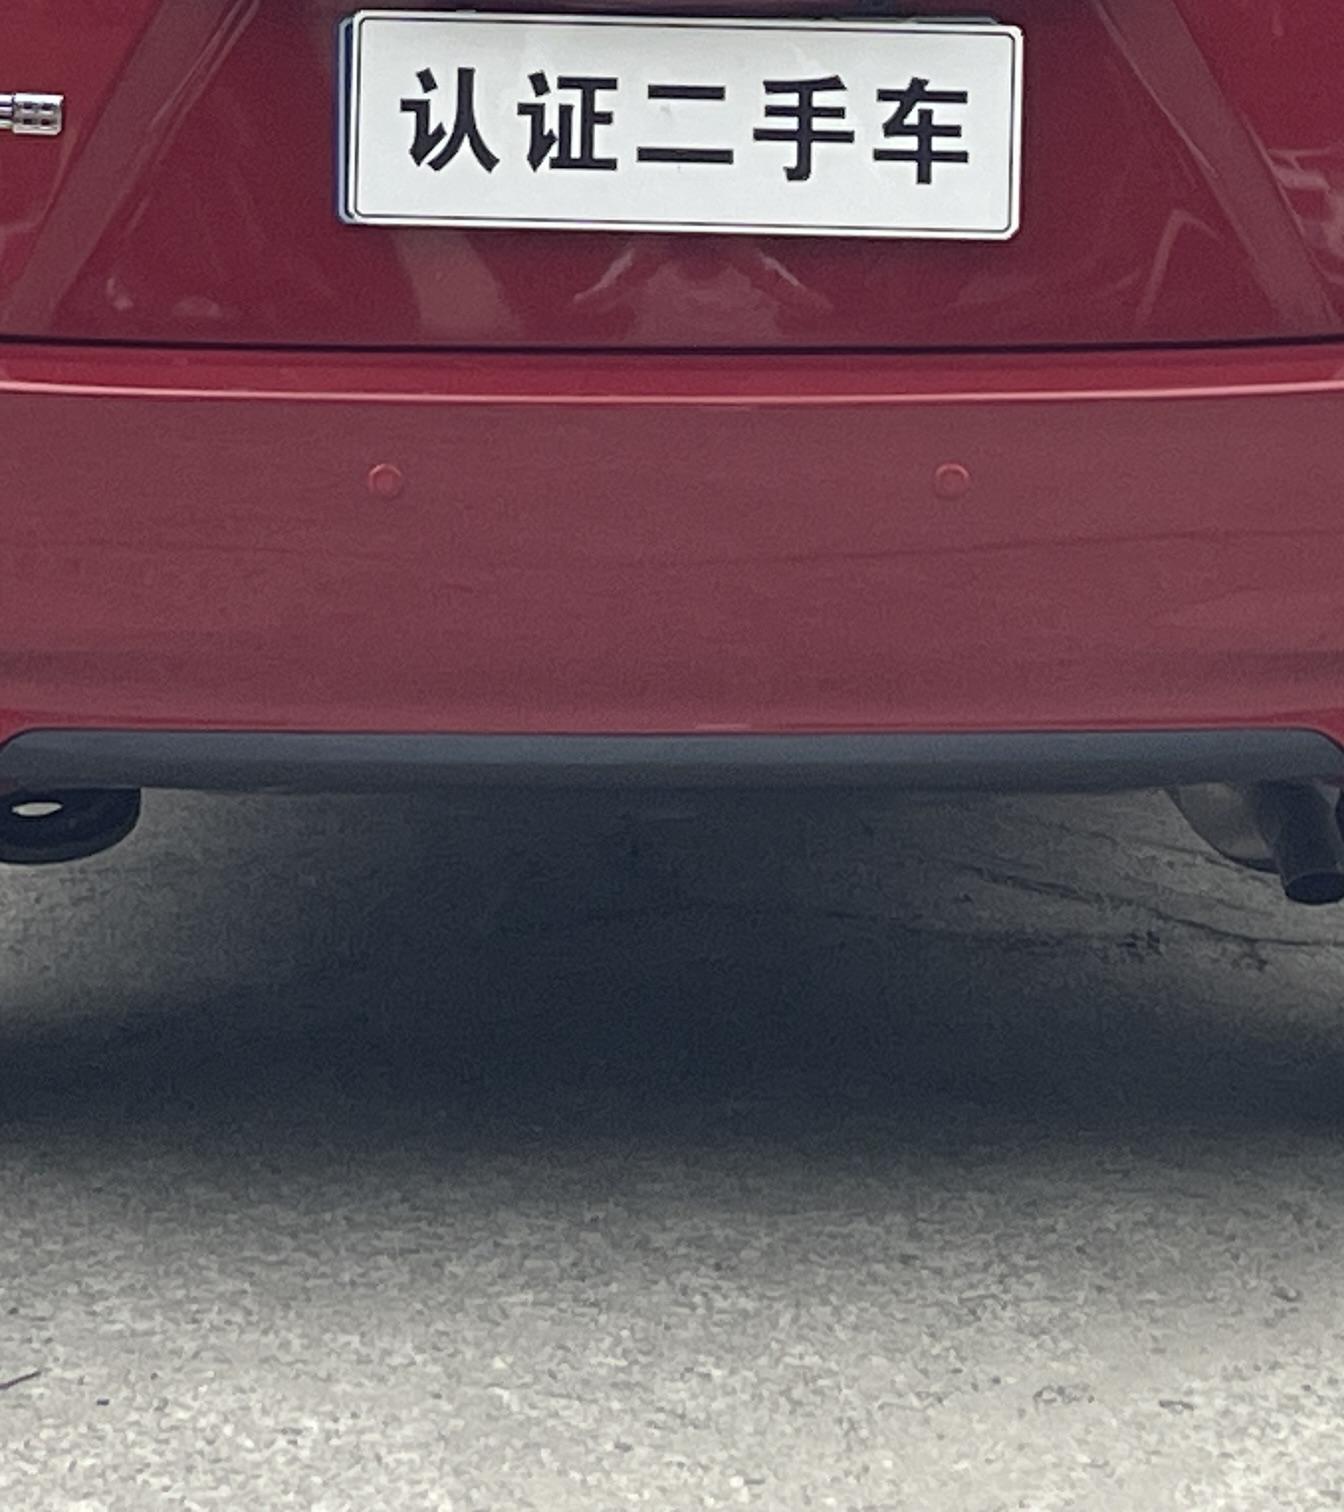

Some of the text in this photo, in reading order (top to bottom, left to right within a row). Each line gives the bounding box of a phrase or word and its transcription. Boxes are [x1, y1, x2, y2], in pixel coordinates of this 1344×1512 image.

[399, 67, 970, 185] 认证二手车
